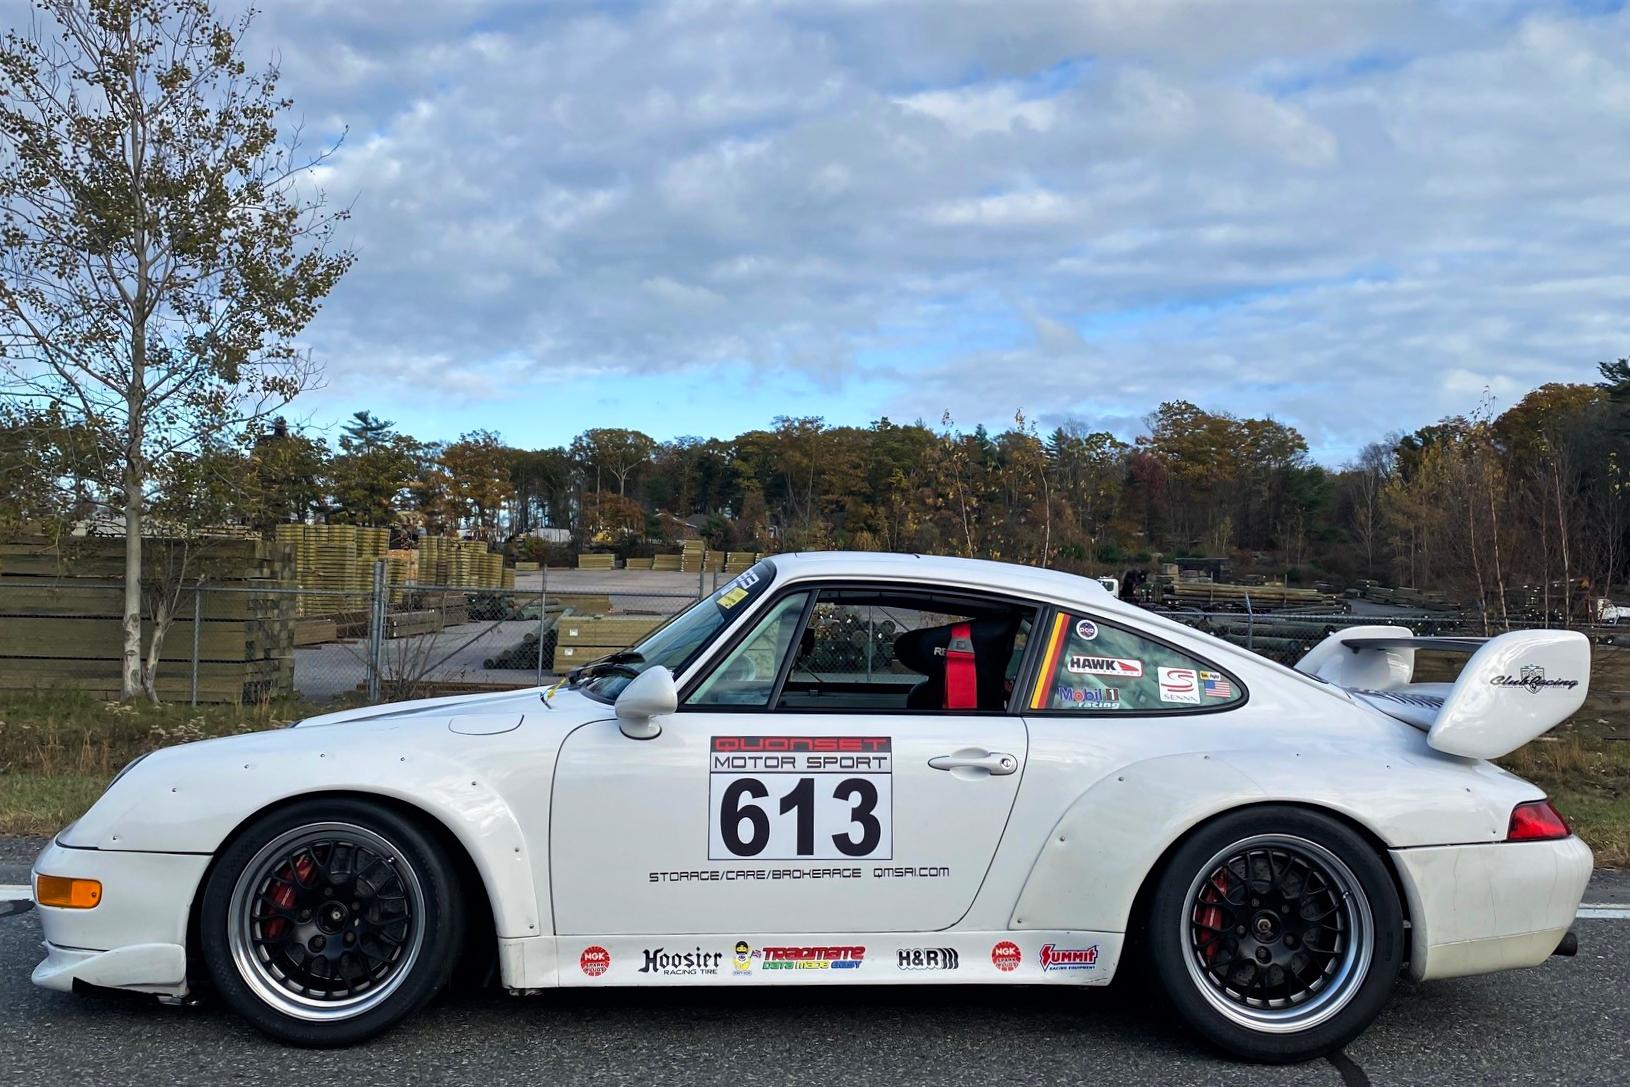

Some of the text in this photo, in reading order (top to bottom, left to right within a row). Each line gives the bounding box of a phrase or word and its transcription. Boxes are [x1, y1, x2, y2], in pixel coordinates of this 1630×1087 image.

[1070, 657, 1116, 671] HAWK
[1057, 687, 1103, 703] Mobil
[1078, 701, 1120, 709] racing
[715, 737, 887, 752] QUONSET
[714, 756, 888, 769] MOTOR SPORT
[720, 777, 882, 857] 613
[584, 952, 605, 960] NGK
[995, 948, 1016, 956] NGK
[638, 946, 722, 973] Hoosier
